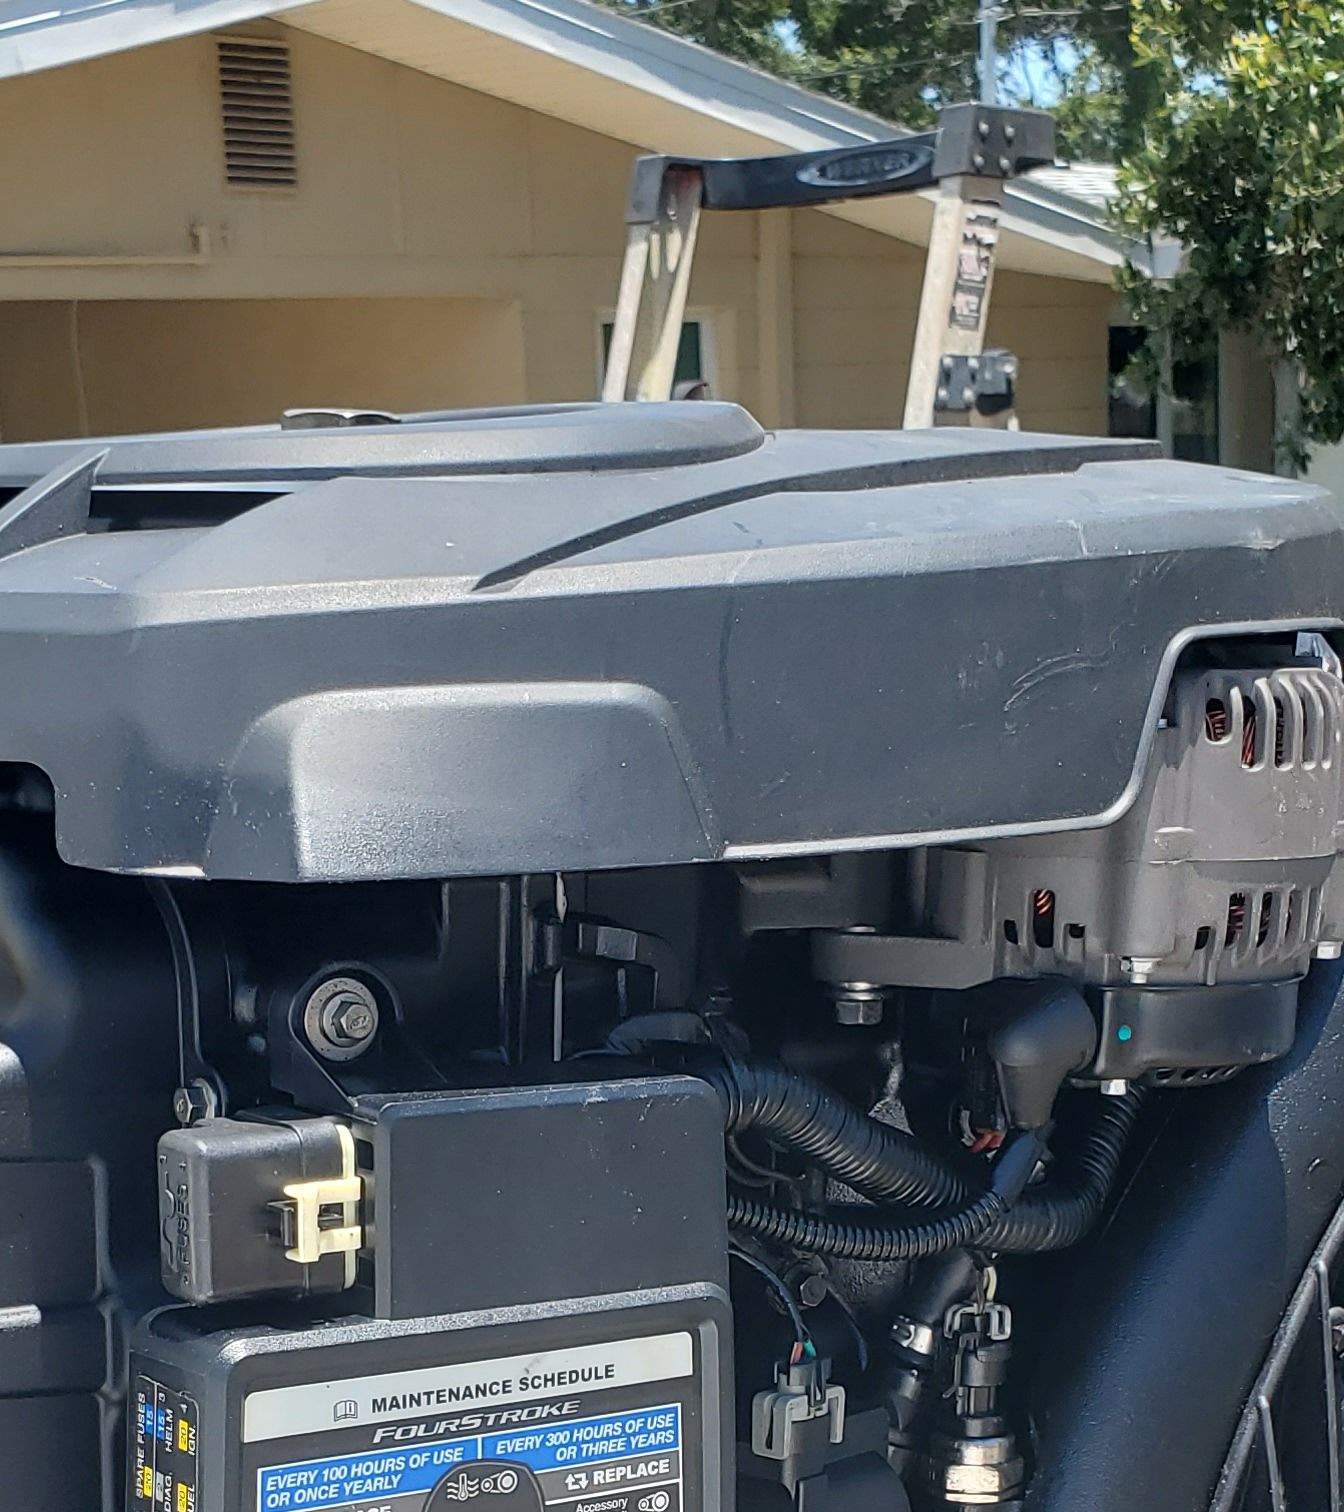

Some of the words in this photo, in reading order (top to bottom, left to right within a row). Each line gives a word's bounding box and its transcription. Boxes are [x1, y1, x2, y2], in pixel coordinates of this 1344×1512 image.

[371, 1379, 513, 1414] MAINTENANCE
[519, 1363, 615, 1392] SCHEDULE
[137, 1392, 146, 1444] FUSES
[165, 1409, 173, 1452] HELM
[372, 1399, 581, 1444] FOURSTROKE
[496, 1434, 543, 1455] EVERY
[545, 1430, 570, 1446] 300
[573, 1422, 622, 1443] HOURS
[625, 1417, 645, 1434] OF
[647, 1413, 675, 1430] USE
[188, 1426, 196, 1455] IGN.
[556, 1447, 577, 1462] OR
[579, 1439, 627, 1460] THREE
[630, 1429, 674, 1451] YEARS
[136, 1449, 145, 1499] SPARE
[265, 1469, 318, 1491] EVERY
[322, 1465, 348, 1484] 100
[350, 1456, 405, 1480] HOURS
[408, 1454, 430, 1469] OF
[433, 1447, 464, 1465] USE
[593, 1458, 670, 1486] REPLACE
[164, 1472, 172, 1512] DIAG.
[266, 1493, 292, 1508] OR
[294, 1485, 339, 1505] ONCE
[342, 1473, 402, 1496] YEARLY
